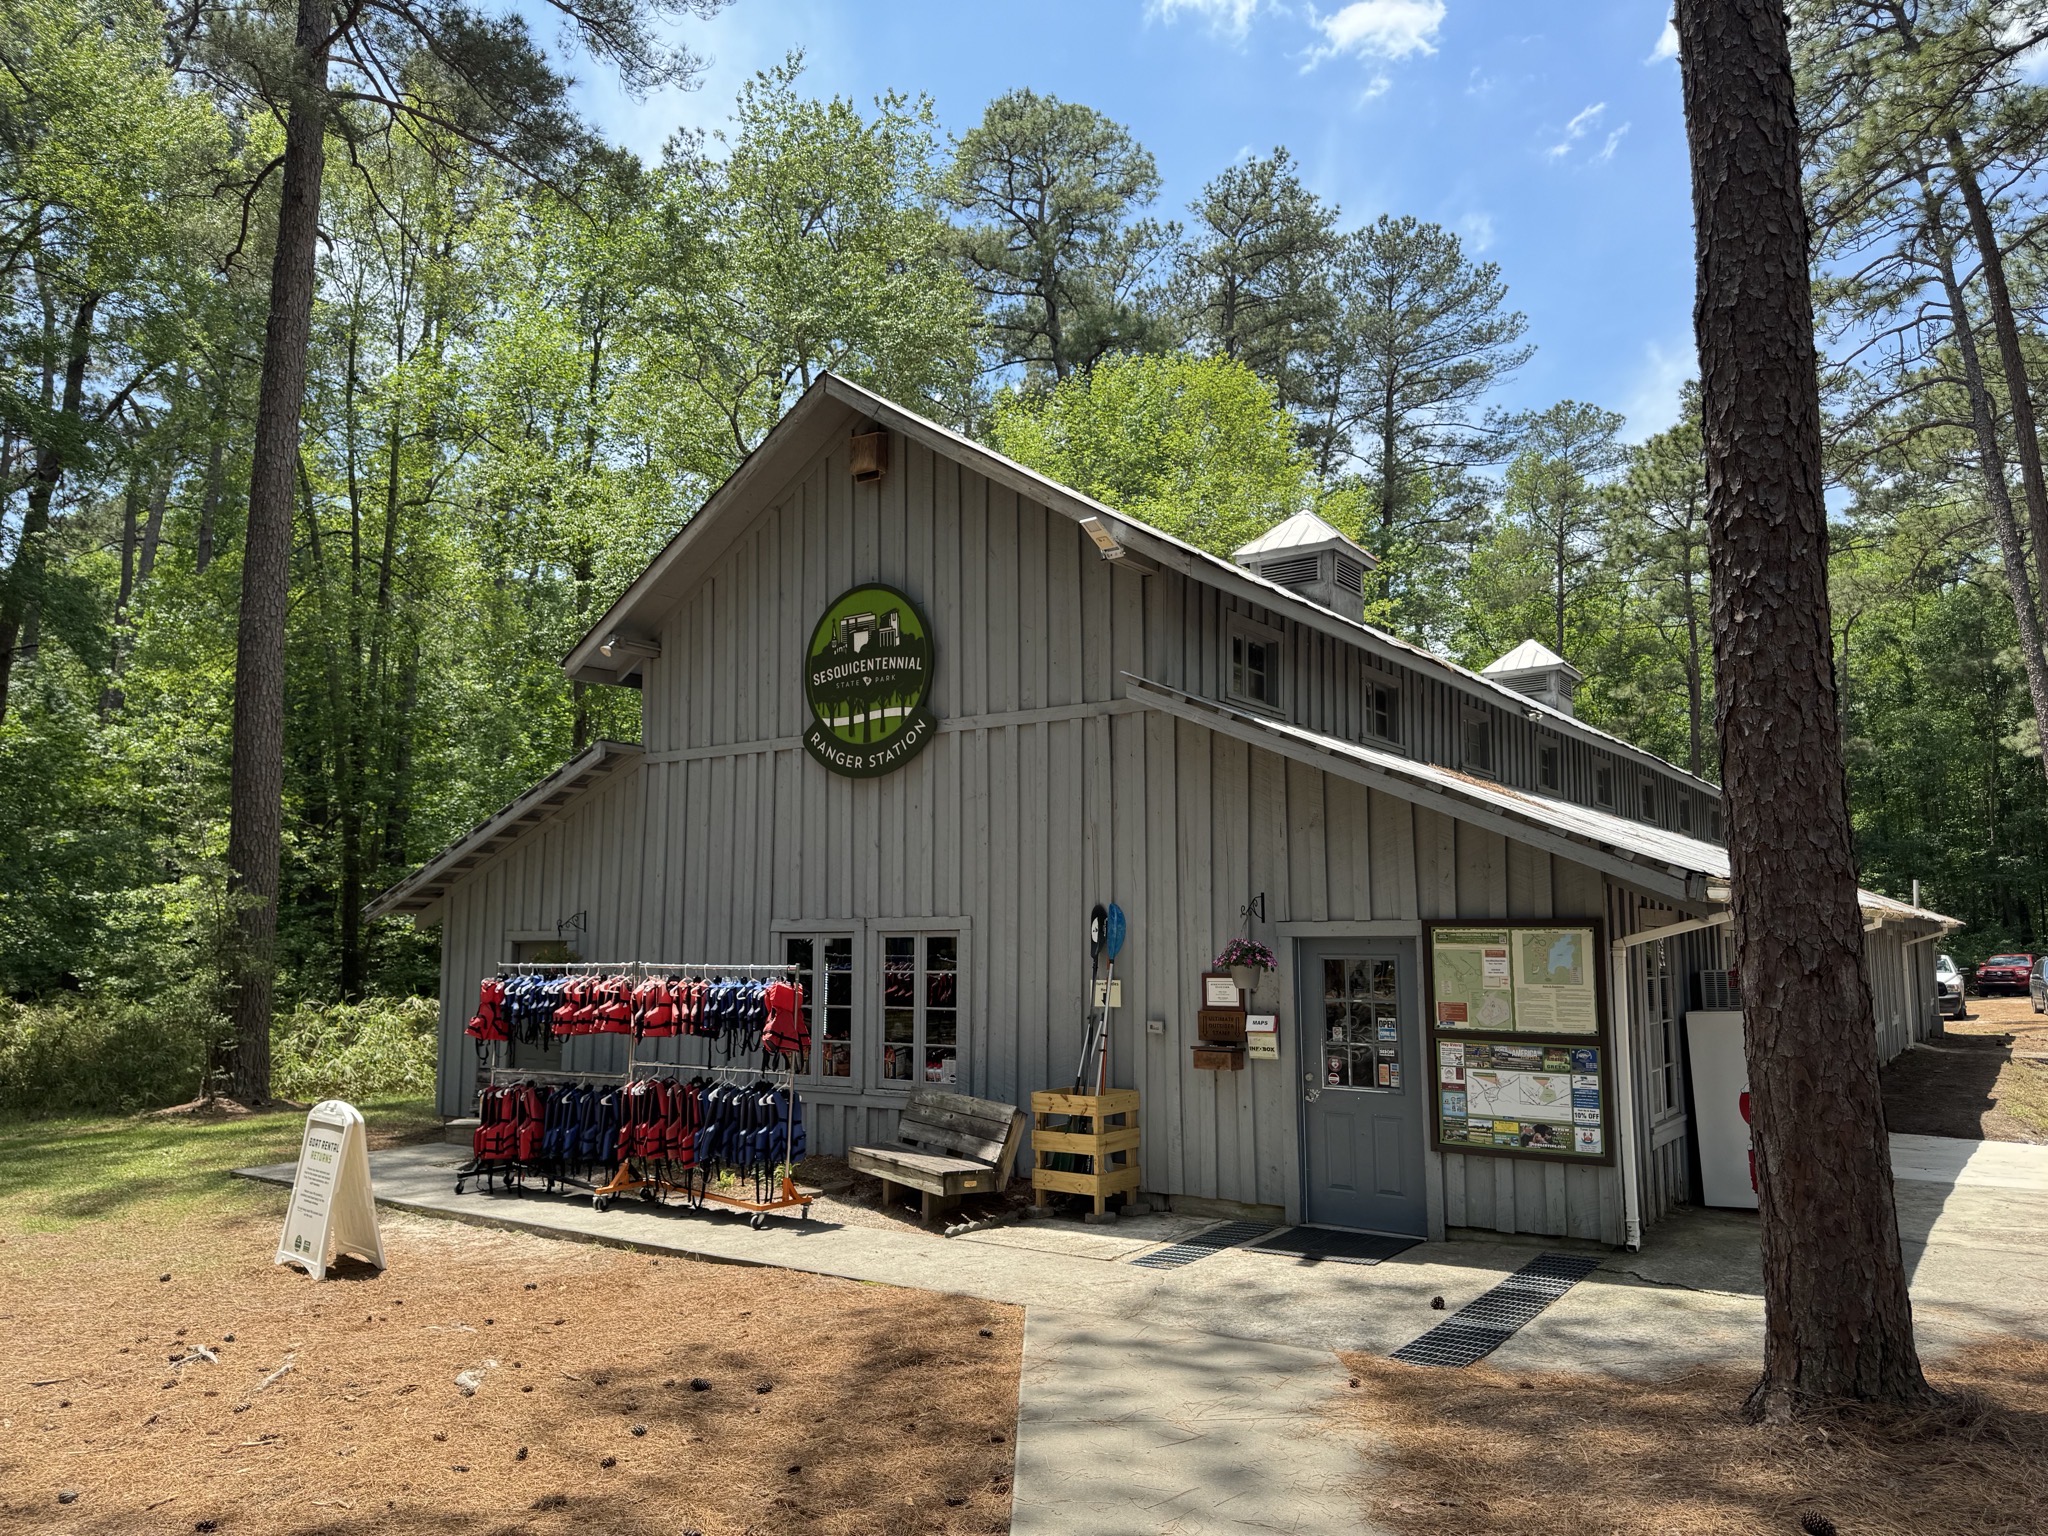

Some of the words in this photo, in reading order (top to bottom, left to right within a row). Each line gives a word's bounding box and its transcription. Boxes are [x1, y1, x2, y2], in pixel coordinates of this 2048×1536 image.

[813, 656, 922, 686] SESQUICENTENNIAL
[836, 680, 860, 689] STATE
[875, 674, 896, 683] PARK
[810, 732, 863, 768] RANGER
[869, 718, 926, 768] STATION
[1511, 1048, 1538, 1058] AMERICA
[308, 1137, 322, 1148] BOAT
[321, 1140, 340, 1153] RENTAL
[310, 1151, 332, 1164] RETURNS
